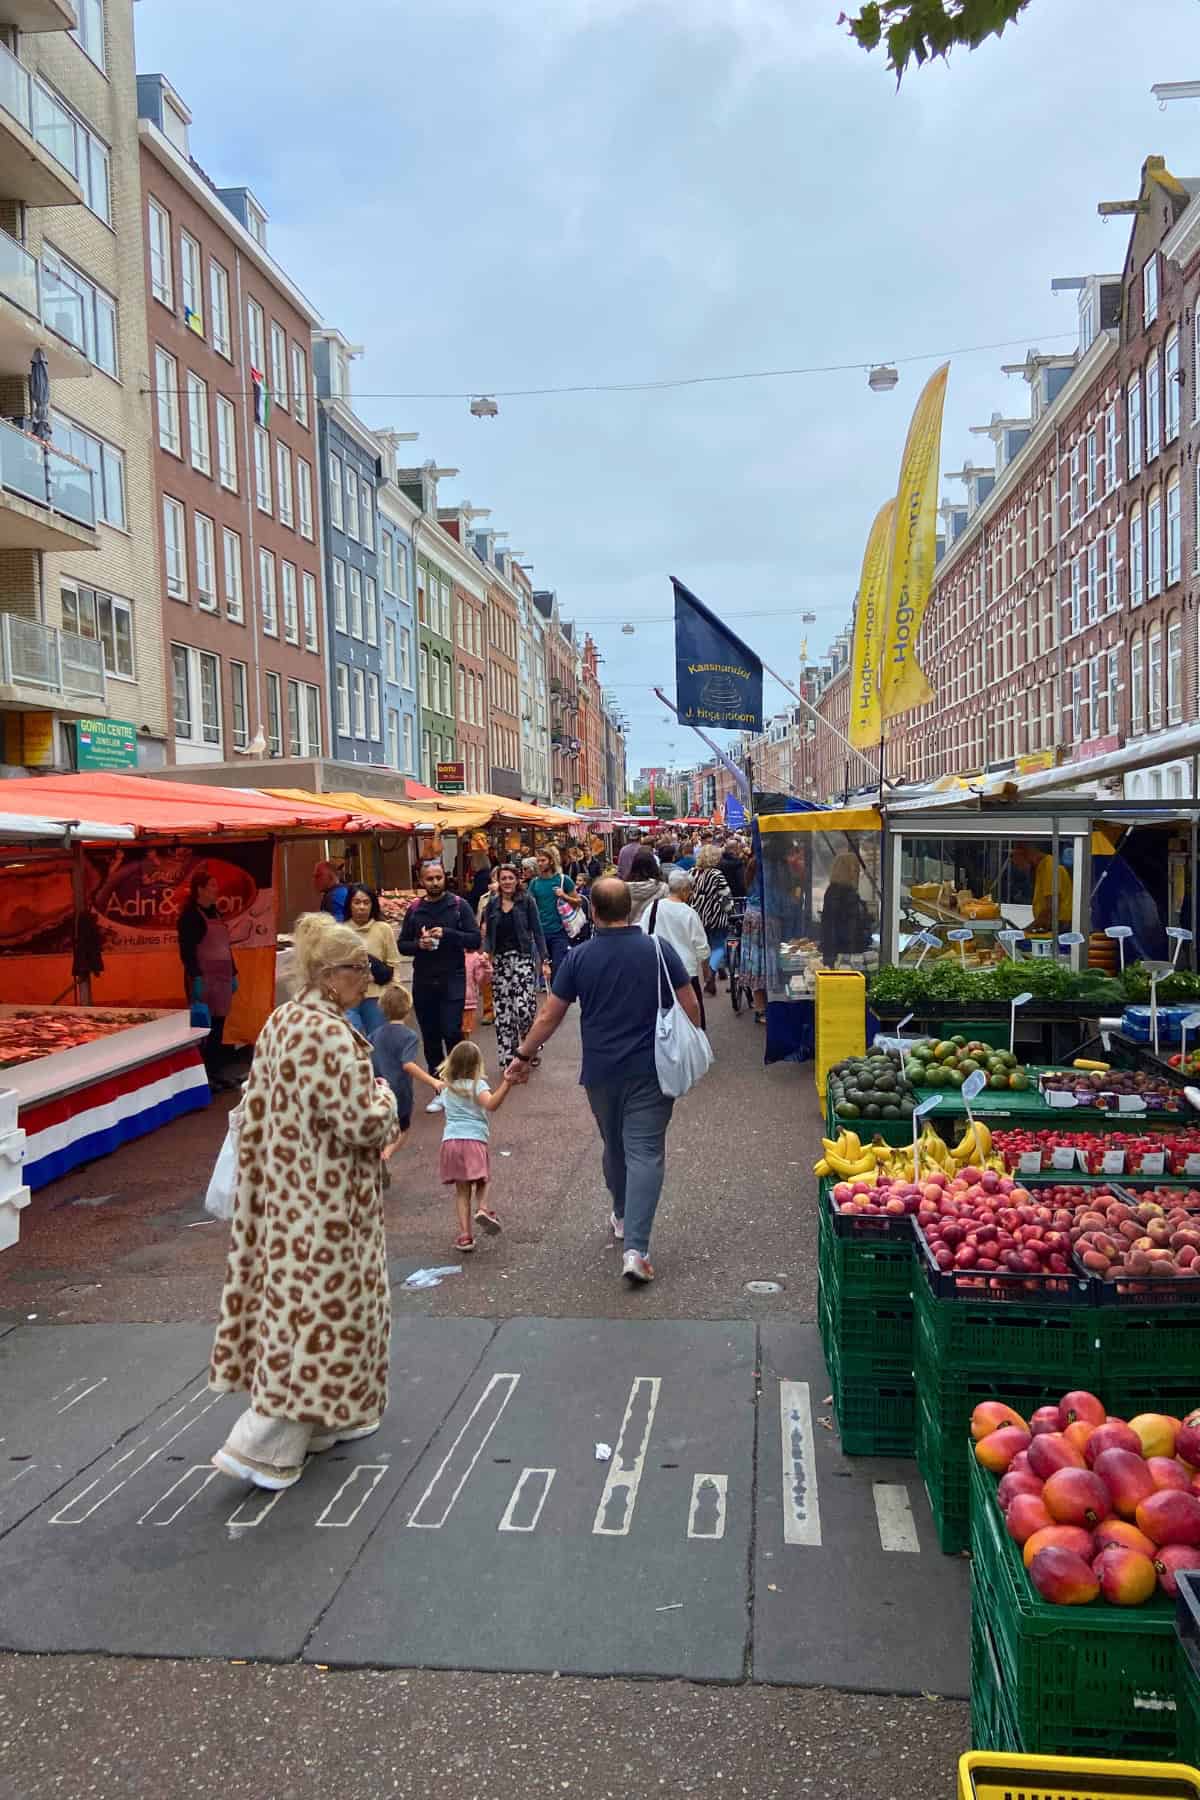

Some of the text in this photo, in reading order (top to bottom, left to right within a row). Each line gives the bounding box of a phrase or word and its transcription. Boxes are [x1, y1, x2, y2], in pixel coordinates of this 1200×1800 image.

[107, 723, 133, 738] CENTRE
[107, 889, 156, 916] Adri
[158, 888, 179, 915] &
